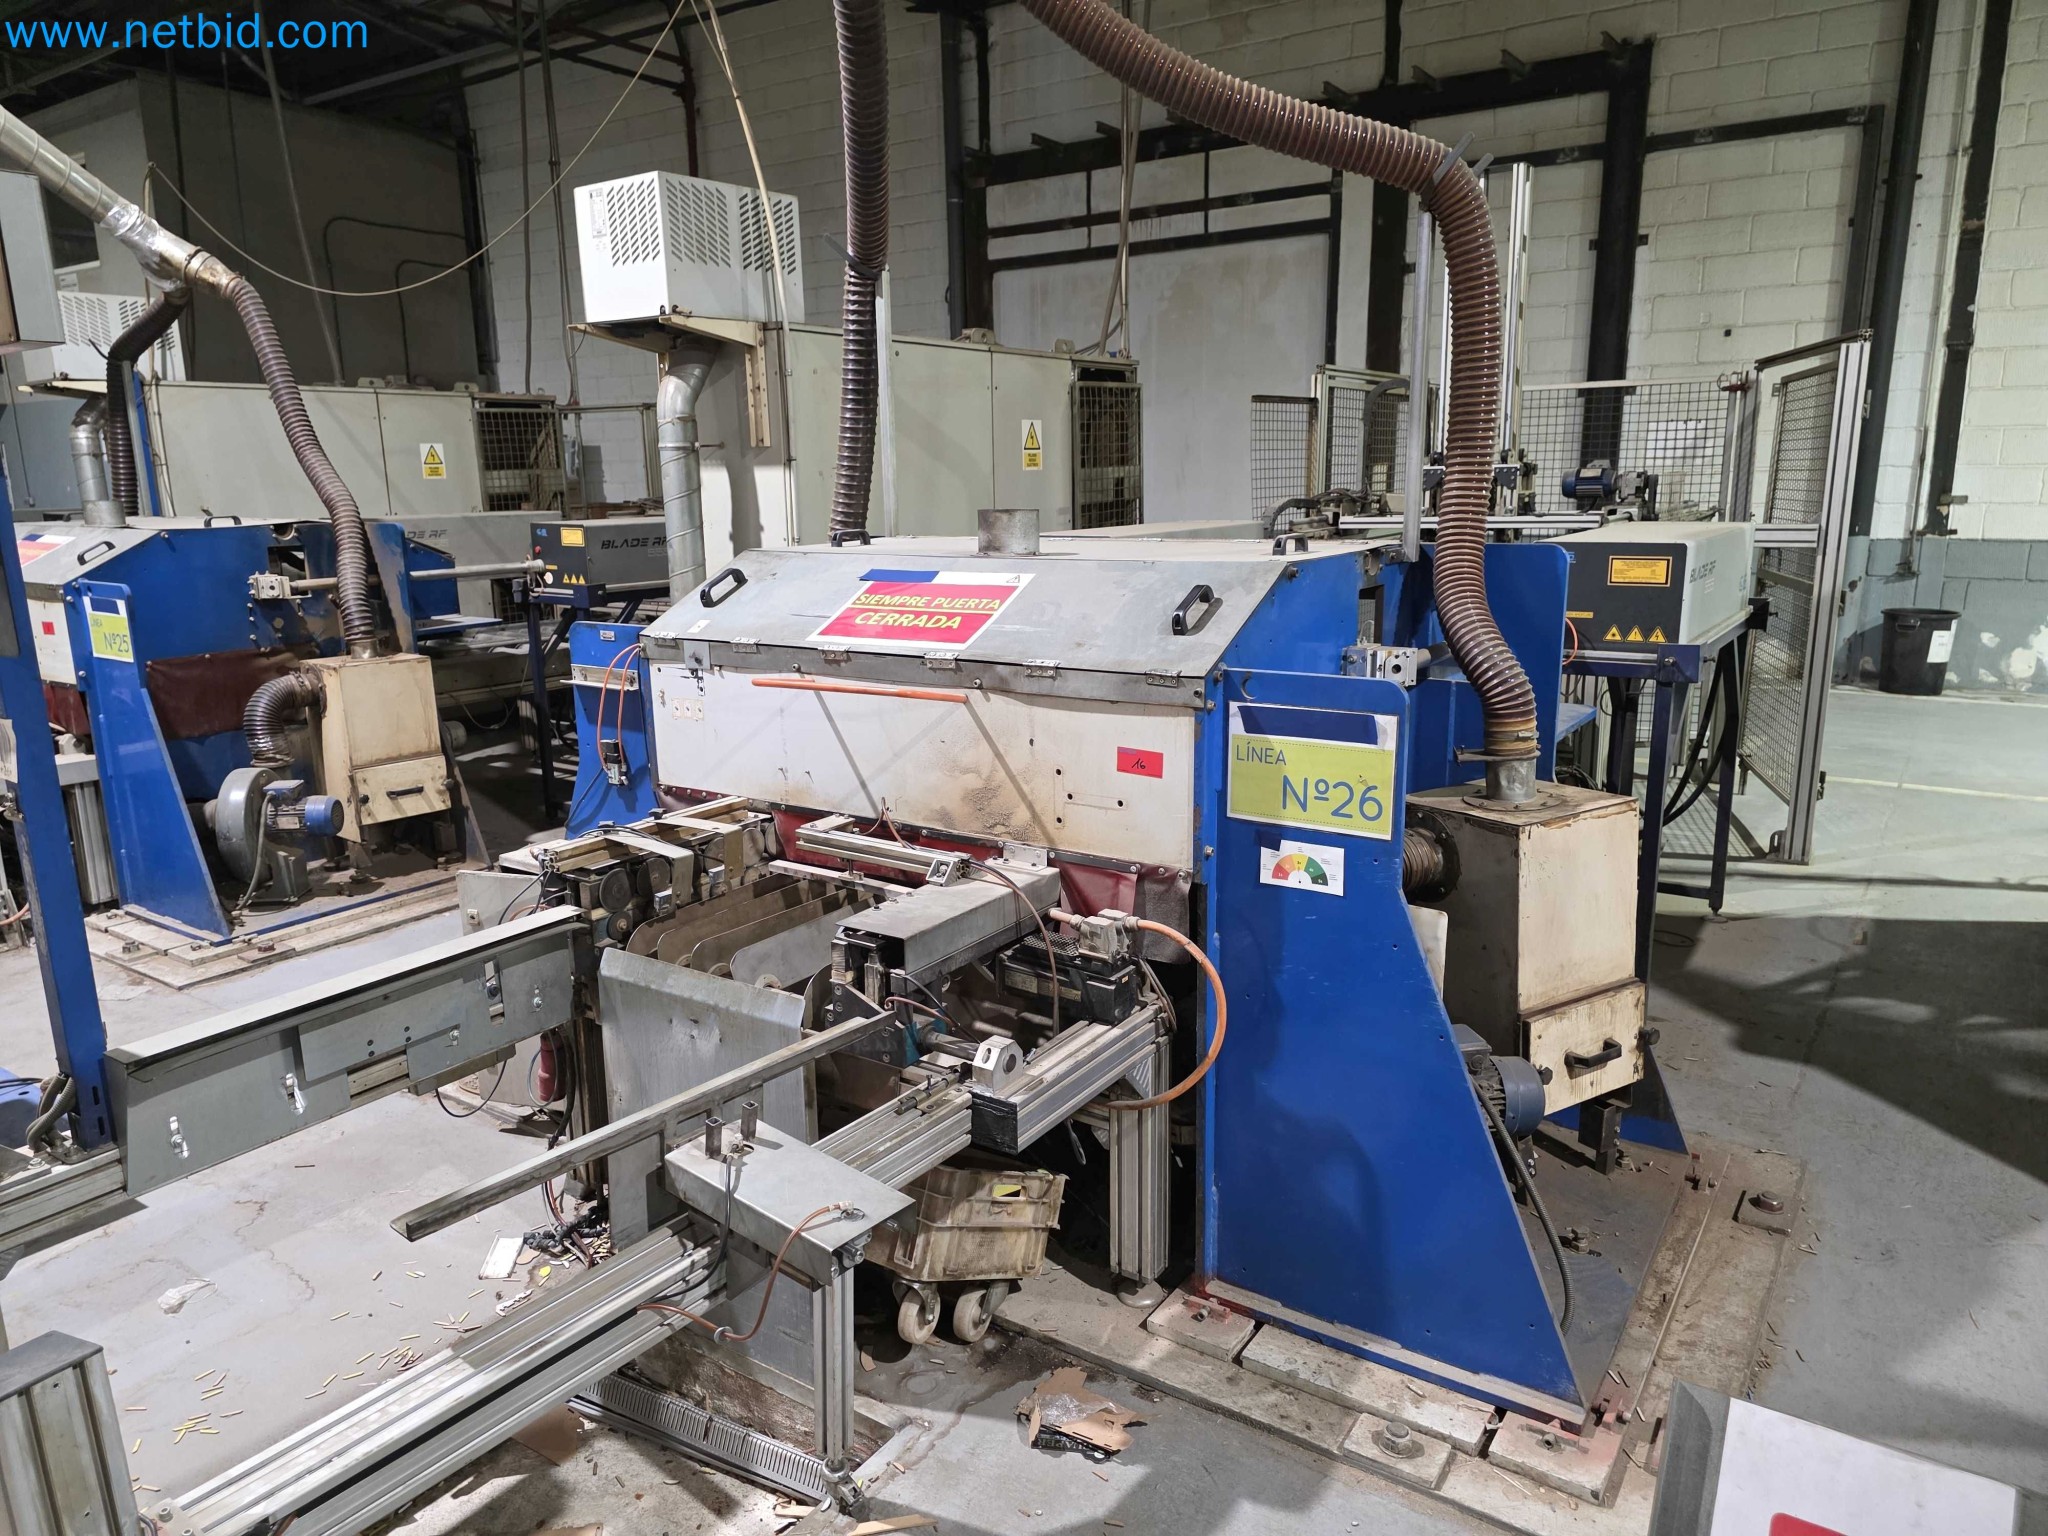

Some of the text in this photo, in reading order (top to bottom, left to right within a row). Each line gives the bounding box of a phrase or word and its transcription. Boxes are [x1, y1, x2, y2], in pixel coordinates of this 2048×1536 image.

[600, 537, 650, 550] BLADE
[855, 593, 1001, 610] SIEMPRE PUERTA
[854, 611, 963, 629] CERRADA
[1236, 741, 1287, 766] LÍNEA
[1131, 758, 1146, 769] 16
[1282, 774, 1384, 822] Nº26
